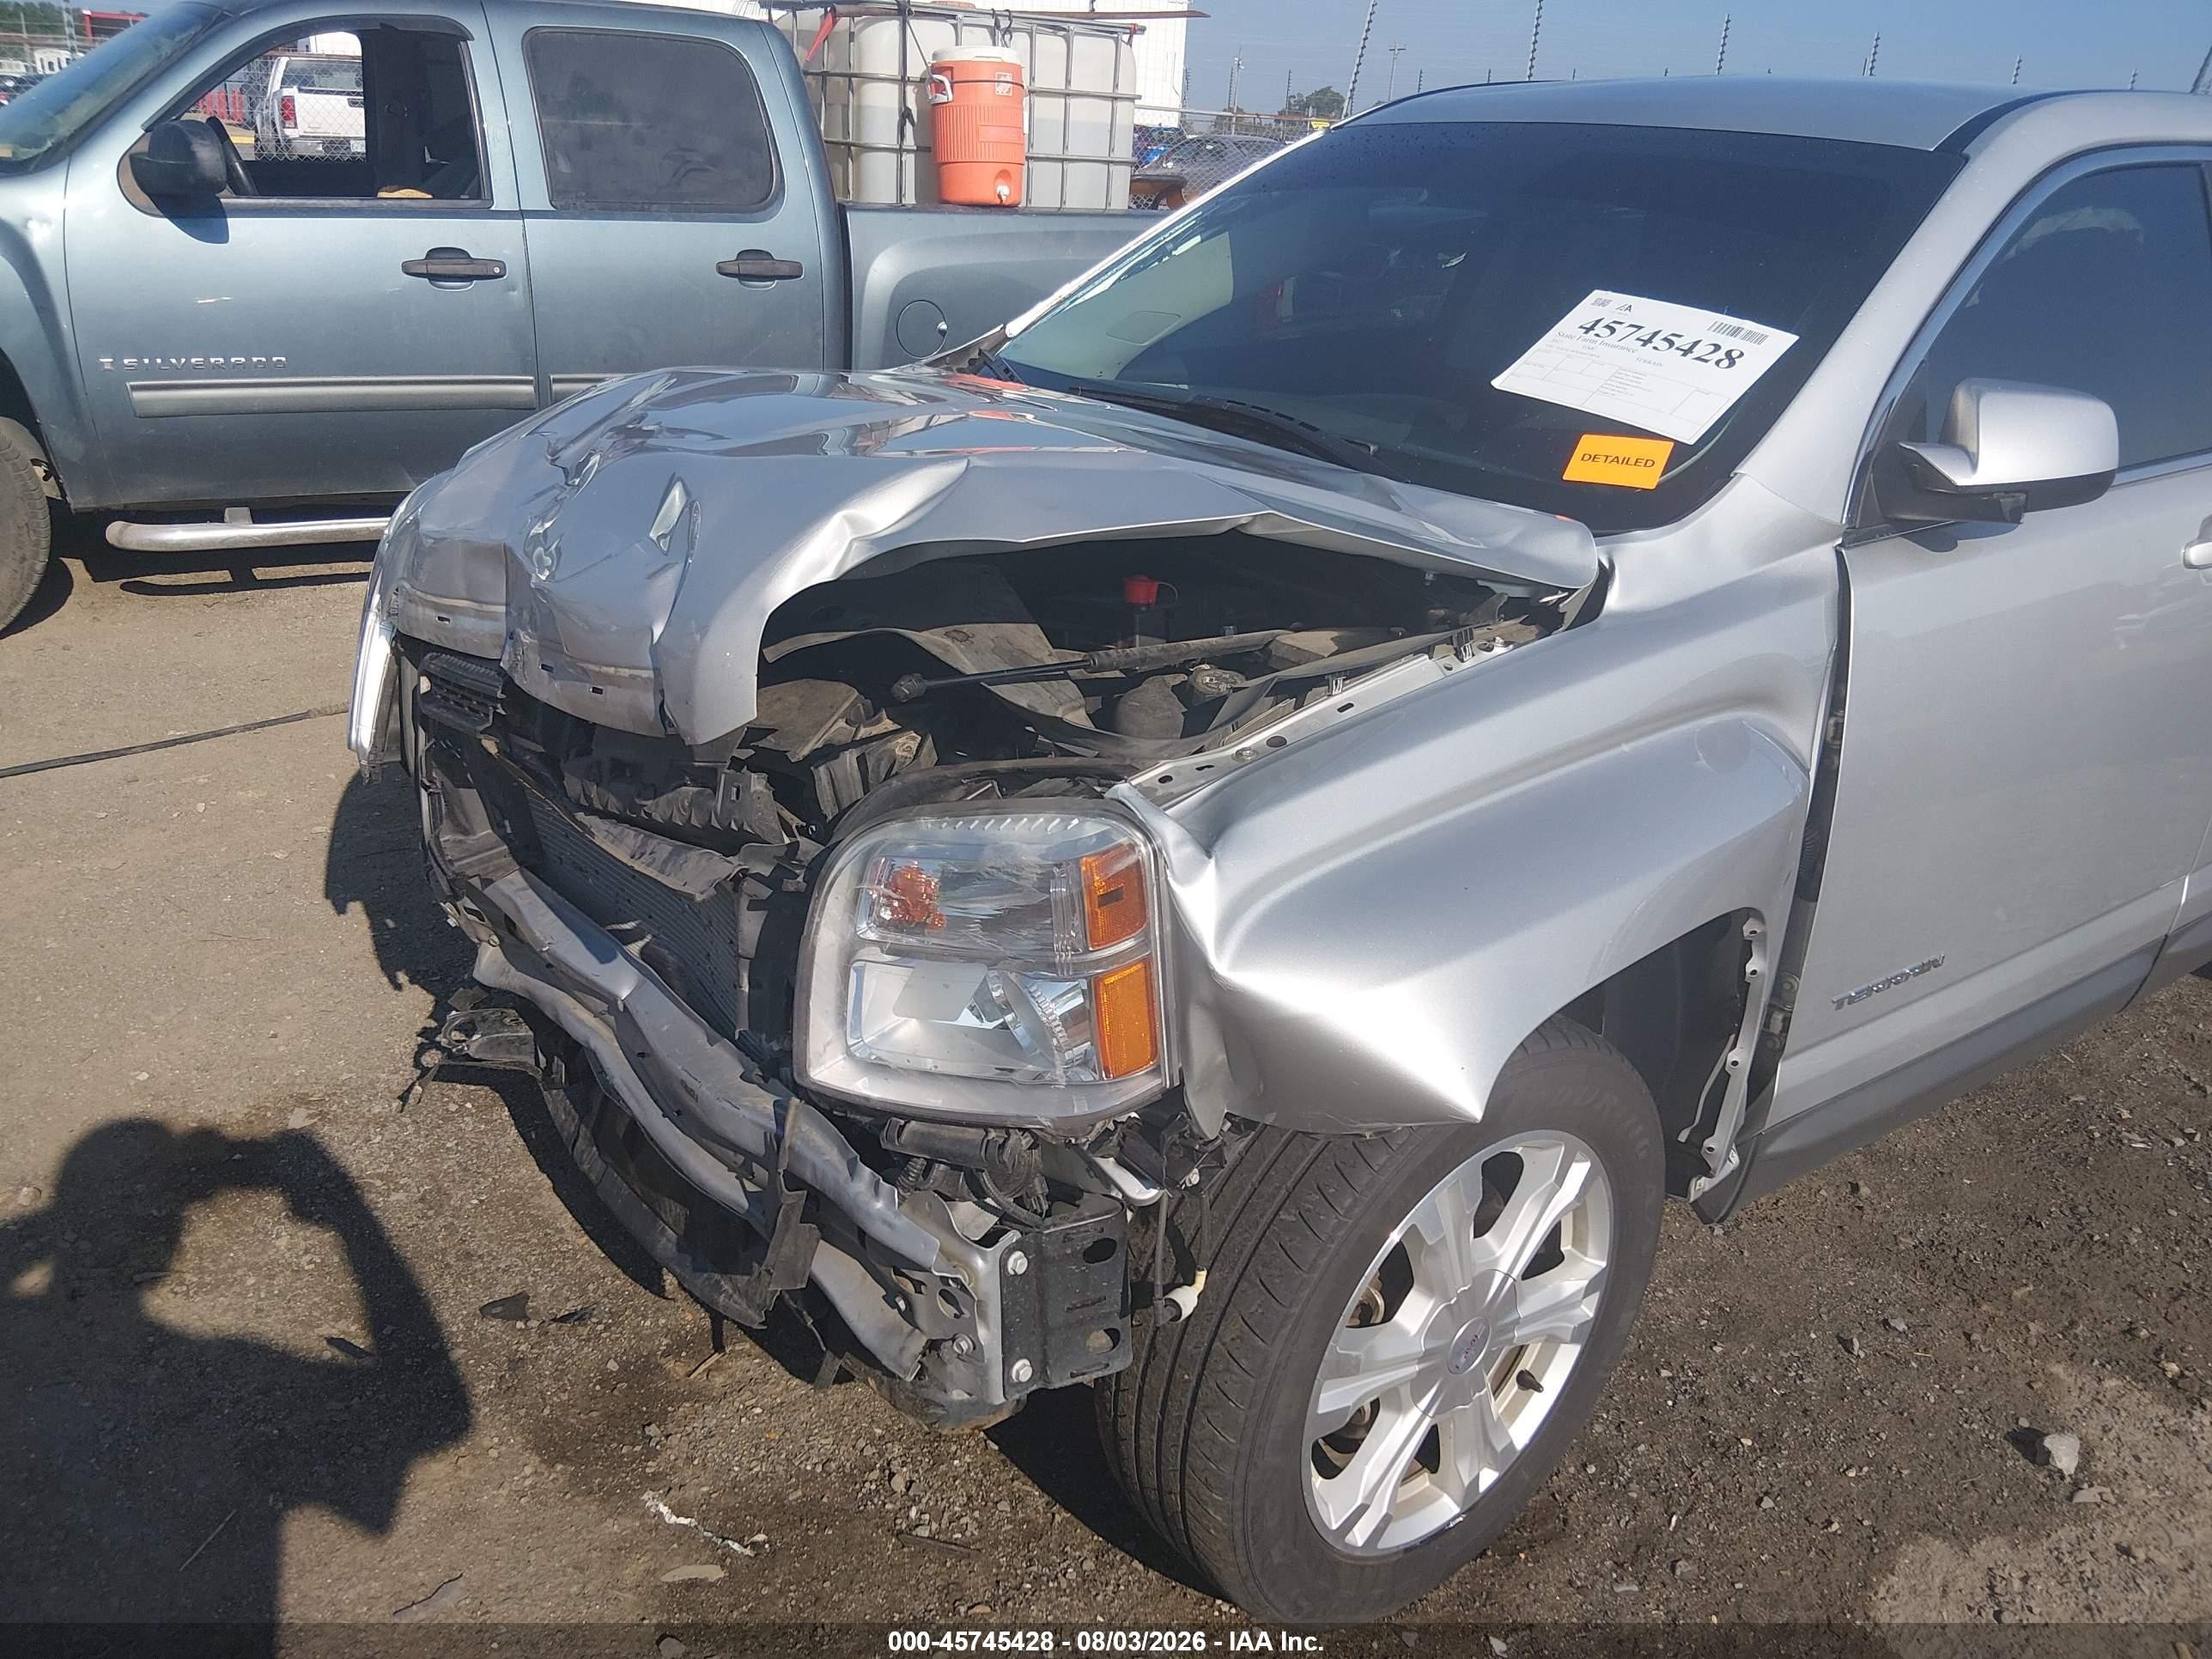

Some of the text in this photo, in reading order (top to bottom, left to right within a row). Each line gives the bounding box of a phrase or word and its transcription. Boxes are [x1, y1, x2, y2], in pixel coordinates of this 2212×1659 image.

[1557, 331, 1577, 341] State
[1577, 317, 1745, 370] 45745428
[123, 356, 288, 372] SILVERADO
[1580, 453, 1656, 469] DETAILED
